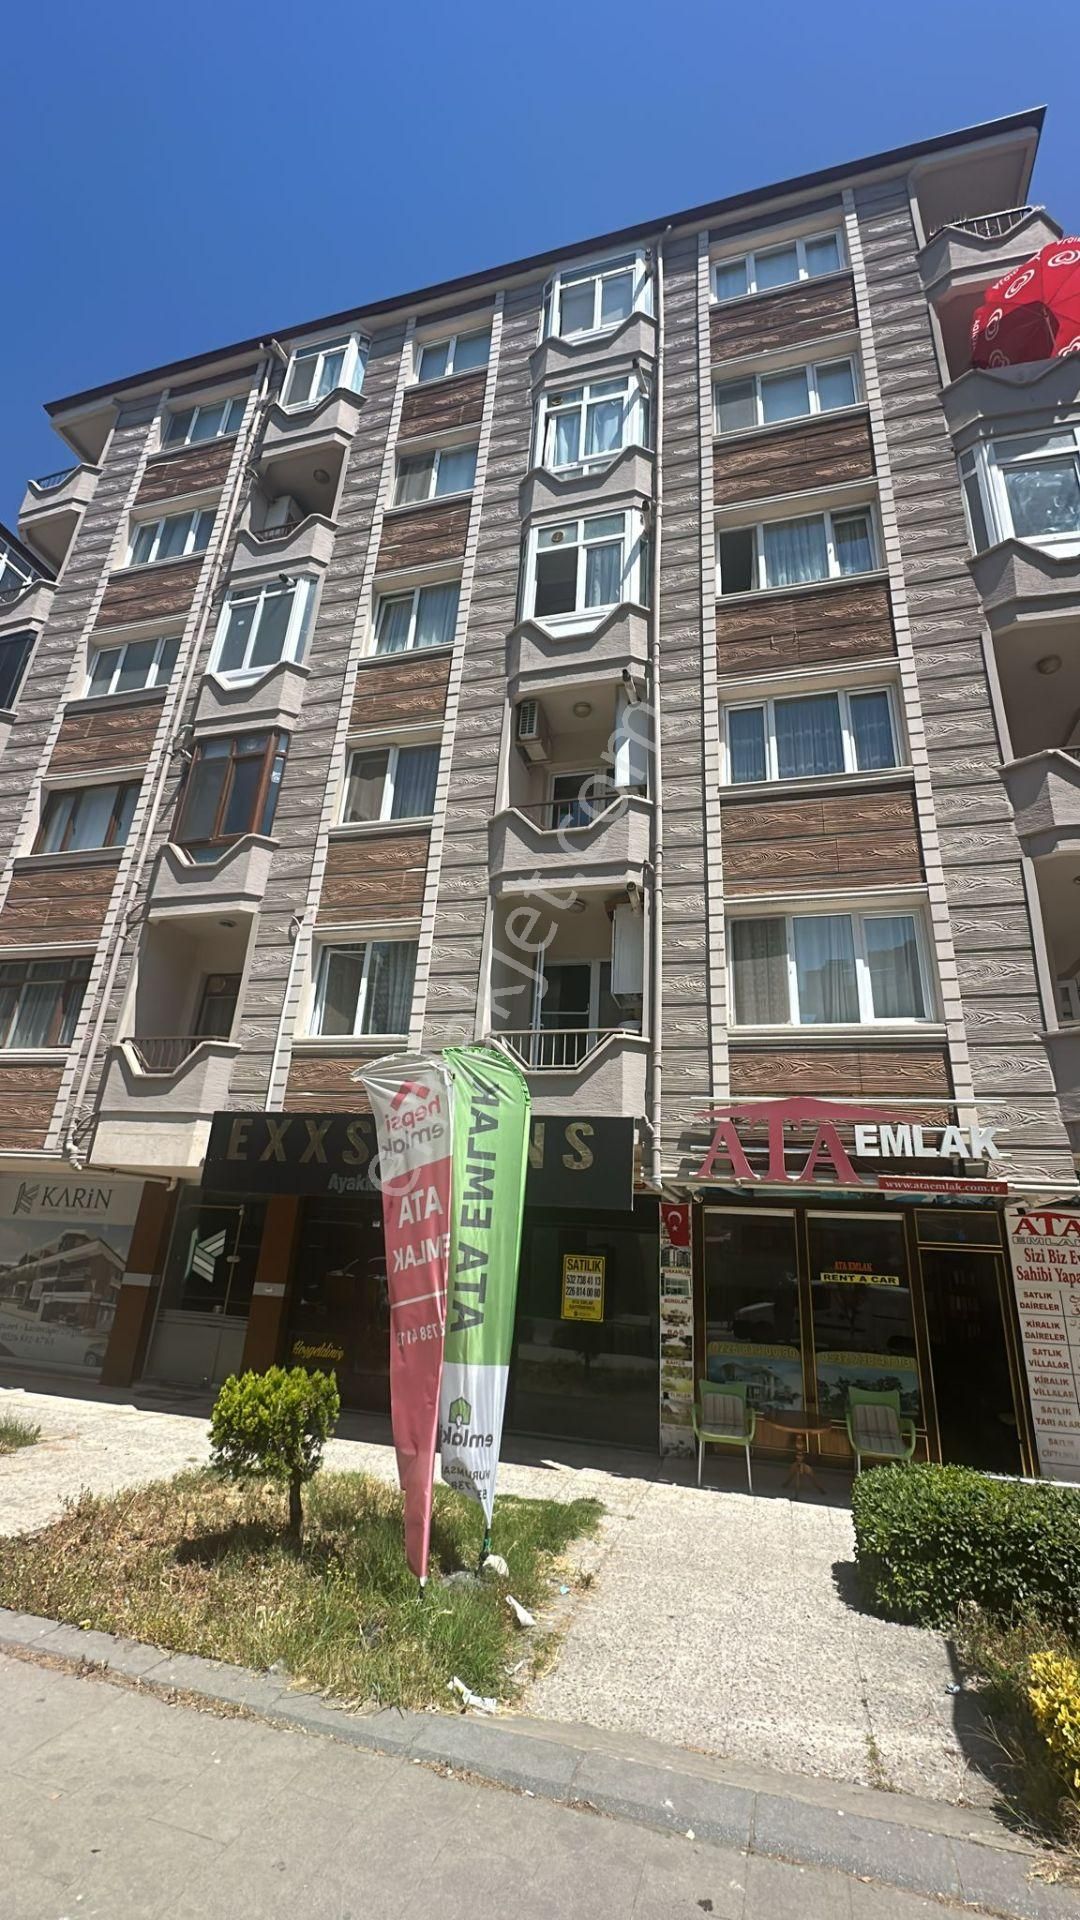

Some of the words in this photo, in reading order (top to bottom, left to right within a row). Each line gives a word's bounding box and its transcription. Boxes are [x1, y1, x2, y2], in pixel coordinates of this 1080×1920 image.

[695, 1117, 864, 1183] ATA
[854, 1124, 1001, 1158] EMLAK
[885, 1180, 1000, 1192] www.ataemlak.com.tr
[1012, 1217, 1080, 1237] ATA
[1024, 1248, 1045, 1263] Sizi
[1048, 1249, 1067, 1264] Biz
[567, 1258, 601, 1272] SATILIK
[823, 1274, 855, 1282] RENT
[857, 1275, 867, 1283] A
[871, 1276, 896, 1284] CAR
[1016, 1265, 1052, 1282] Sahibi
